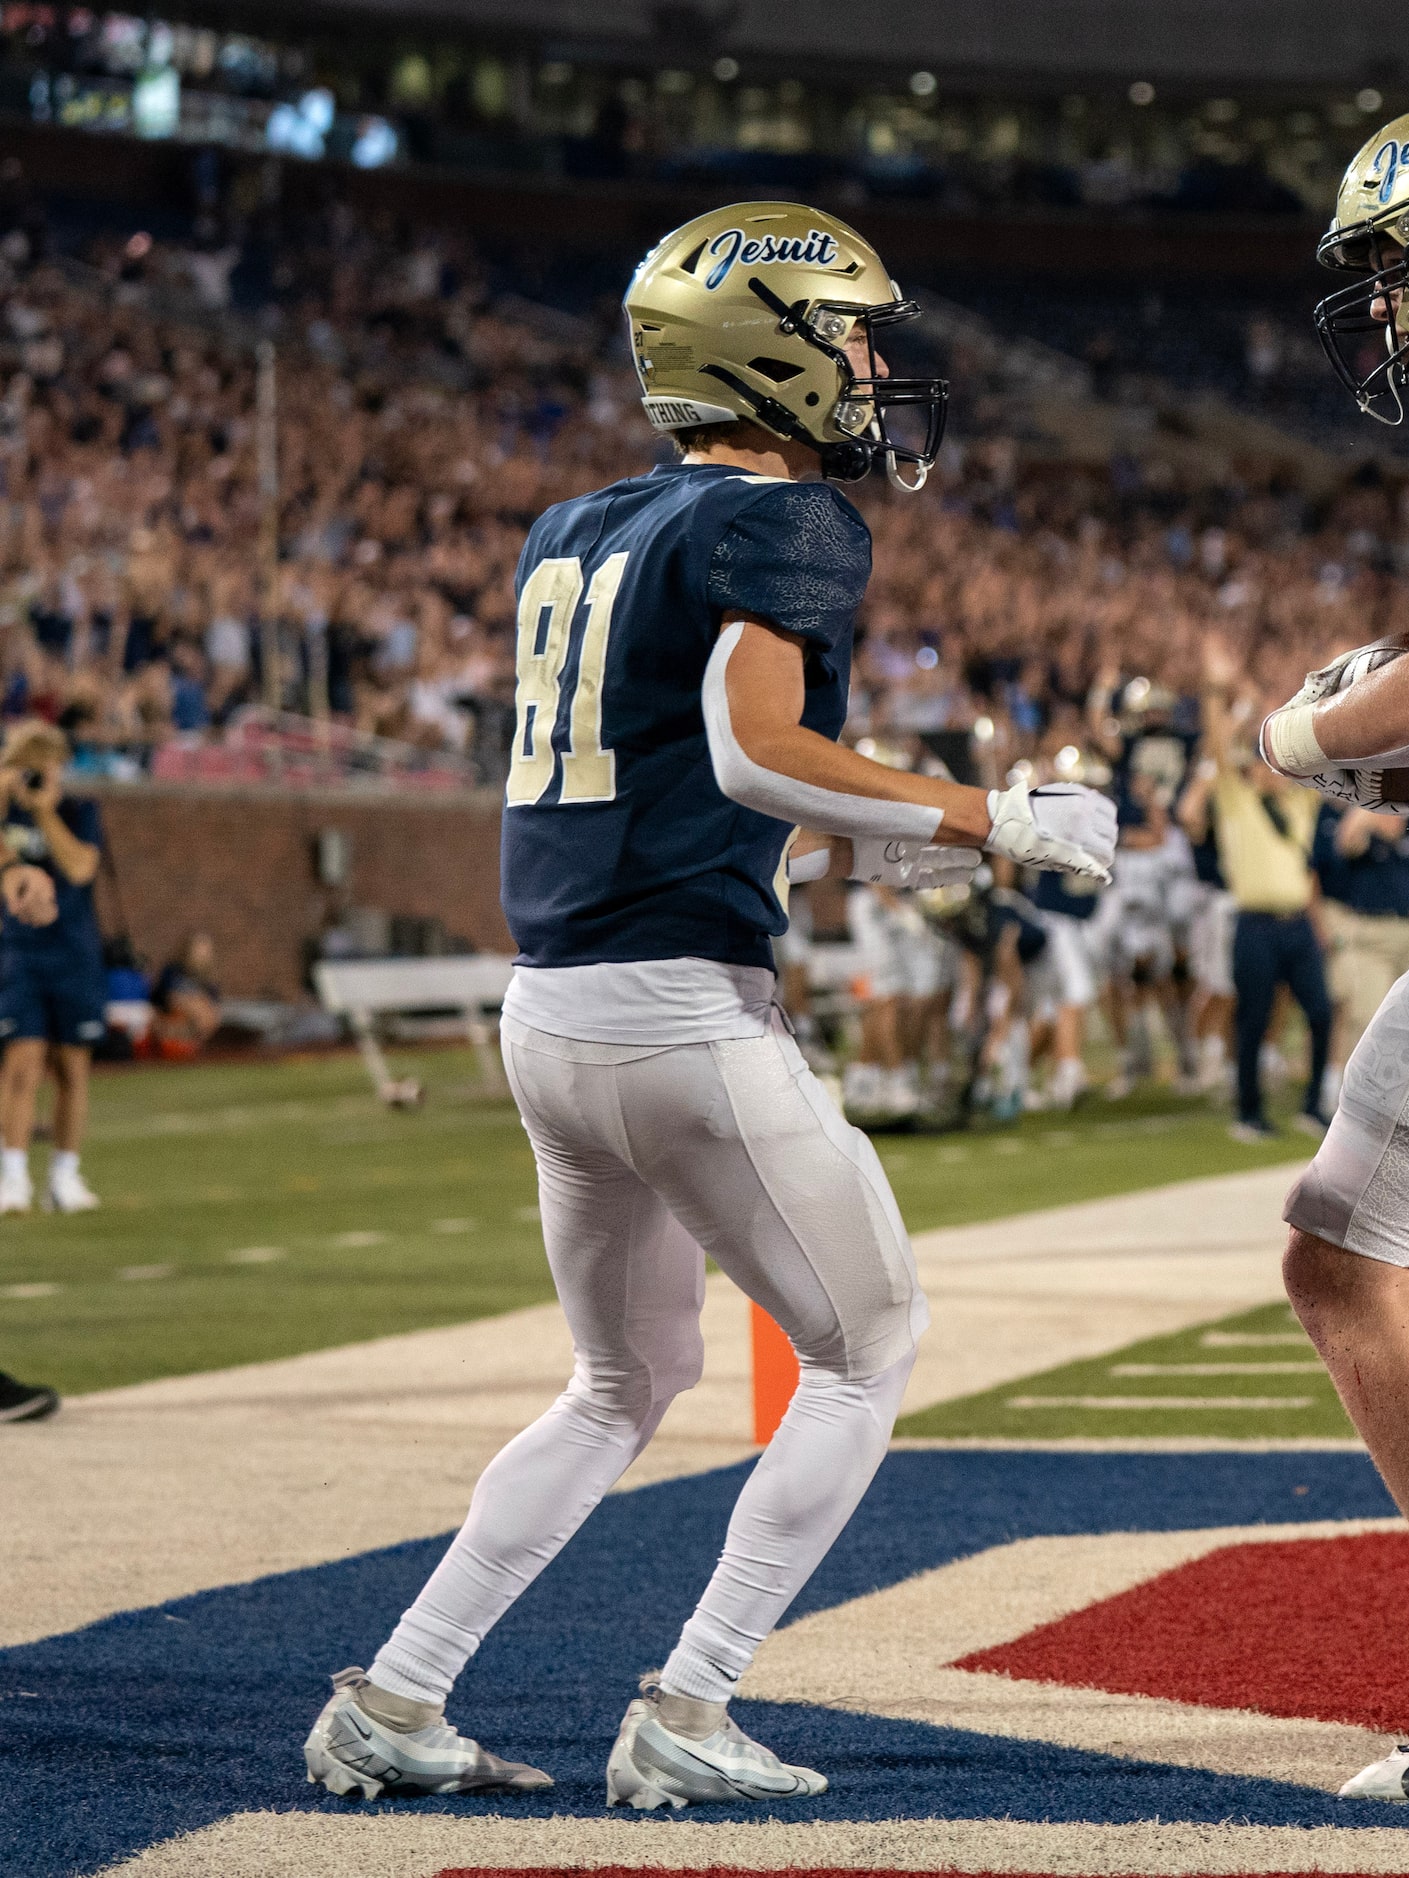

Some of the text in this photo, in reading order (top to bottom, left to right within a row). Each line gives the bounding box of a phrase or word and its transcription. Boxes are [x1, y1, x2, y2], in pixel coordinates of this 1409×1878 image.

[704, 228, 841, 292] Jesuit
[646, 403, 702, 424] THING
[506, 551, 630, 807] 81
